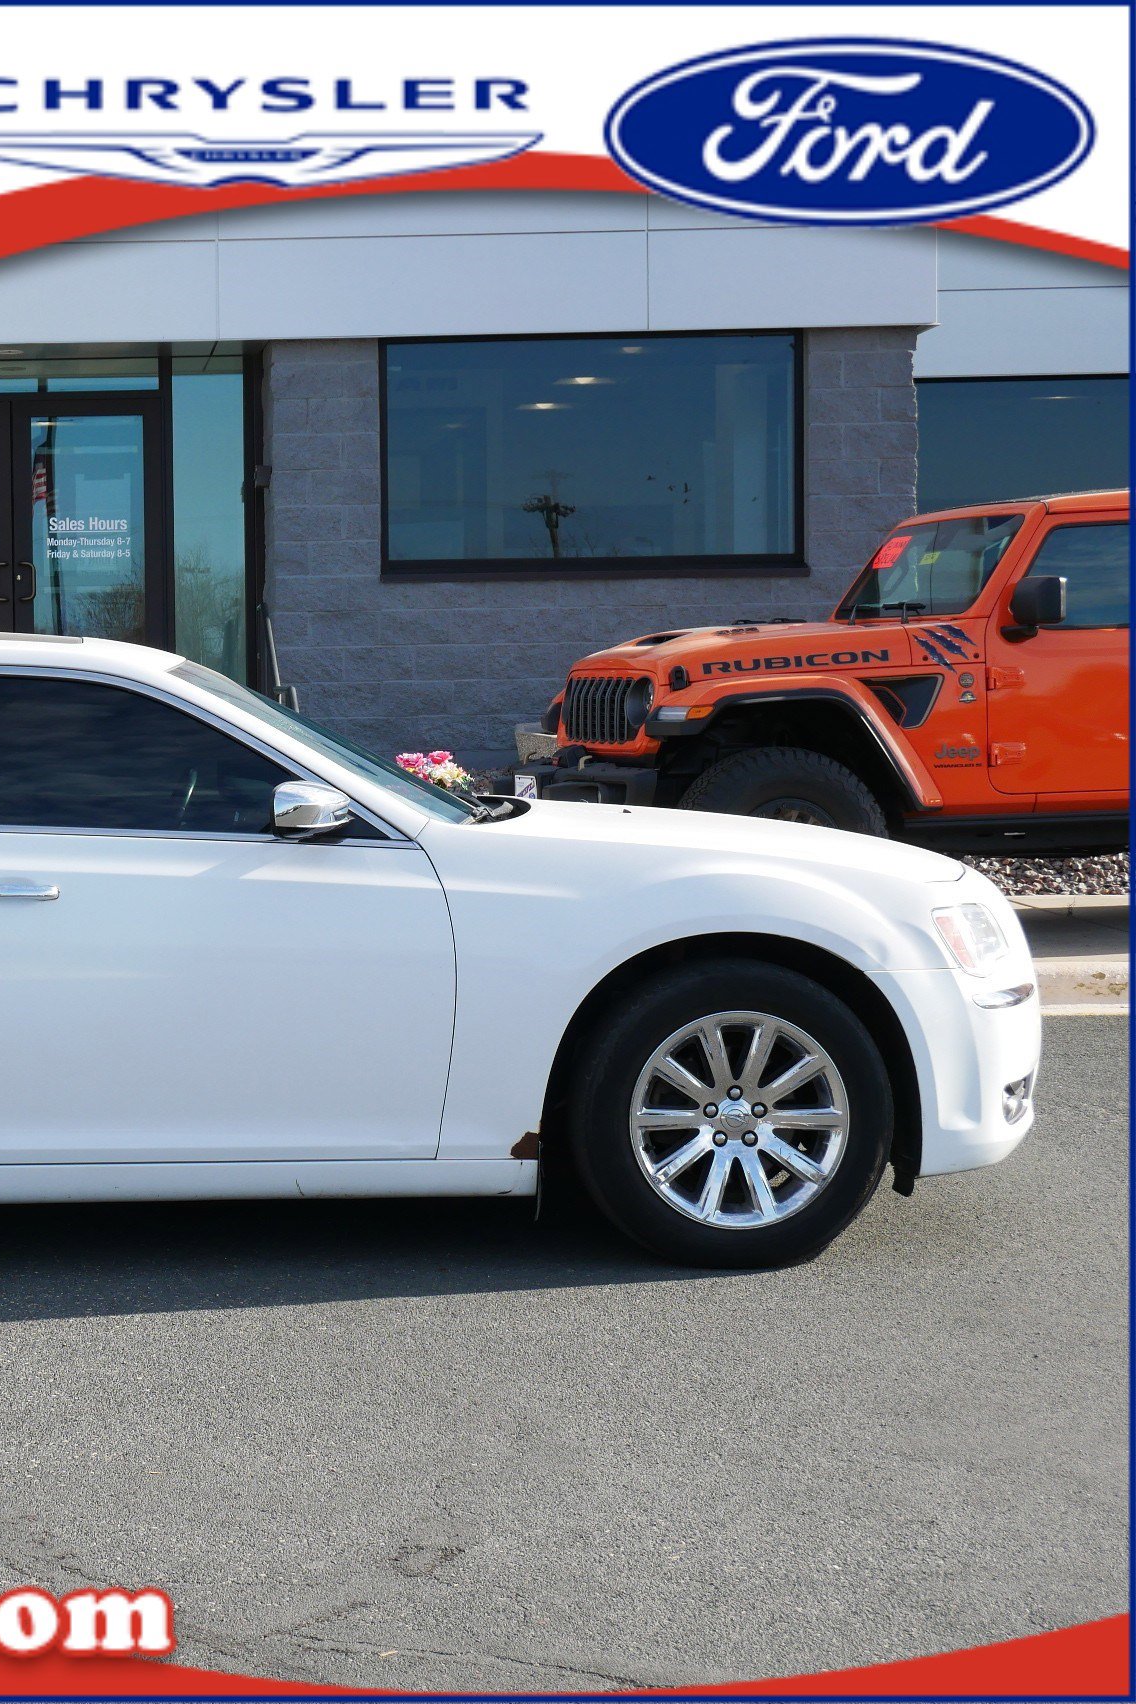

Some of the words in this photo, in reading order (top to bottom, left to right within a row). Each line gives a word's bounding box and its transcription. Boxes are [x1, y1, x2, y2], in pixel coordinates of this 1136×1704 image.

[49, 517, 85, 531] Sales
[89, 517, 127, 531] Hours
[46, 537, 115, 547] Monday-Thursday
[117, 537, 131, 545] 8-7
[46, 549, 70, 559] Friday
[72, 549, 79, 558] &
[80, 549, 115, 558] Saturday
[117, 549, 131, 558] 8-5
[702, 649, 890, 675] RUBICON
[934, 743, 981, 761] Jeep
